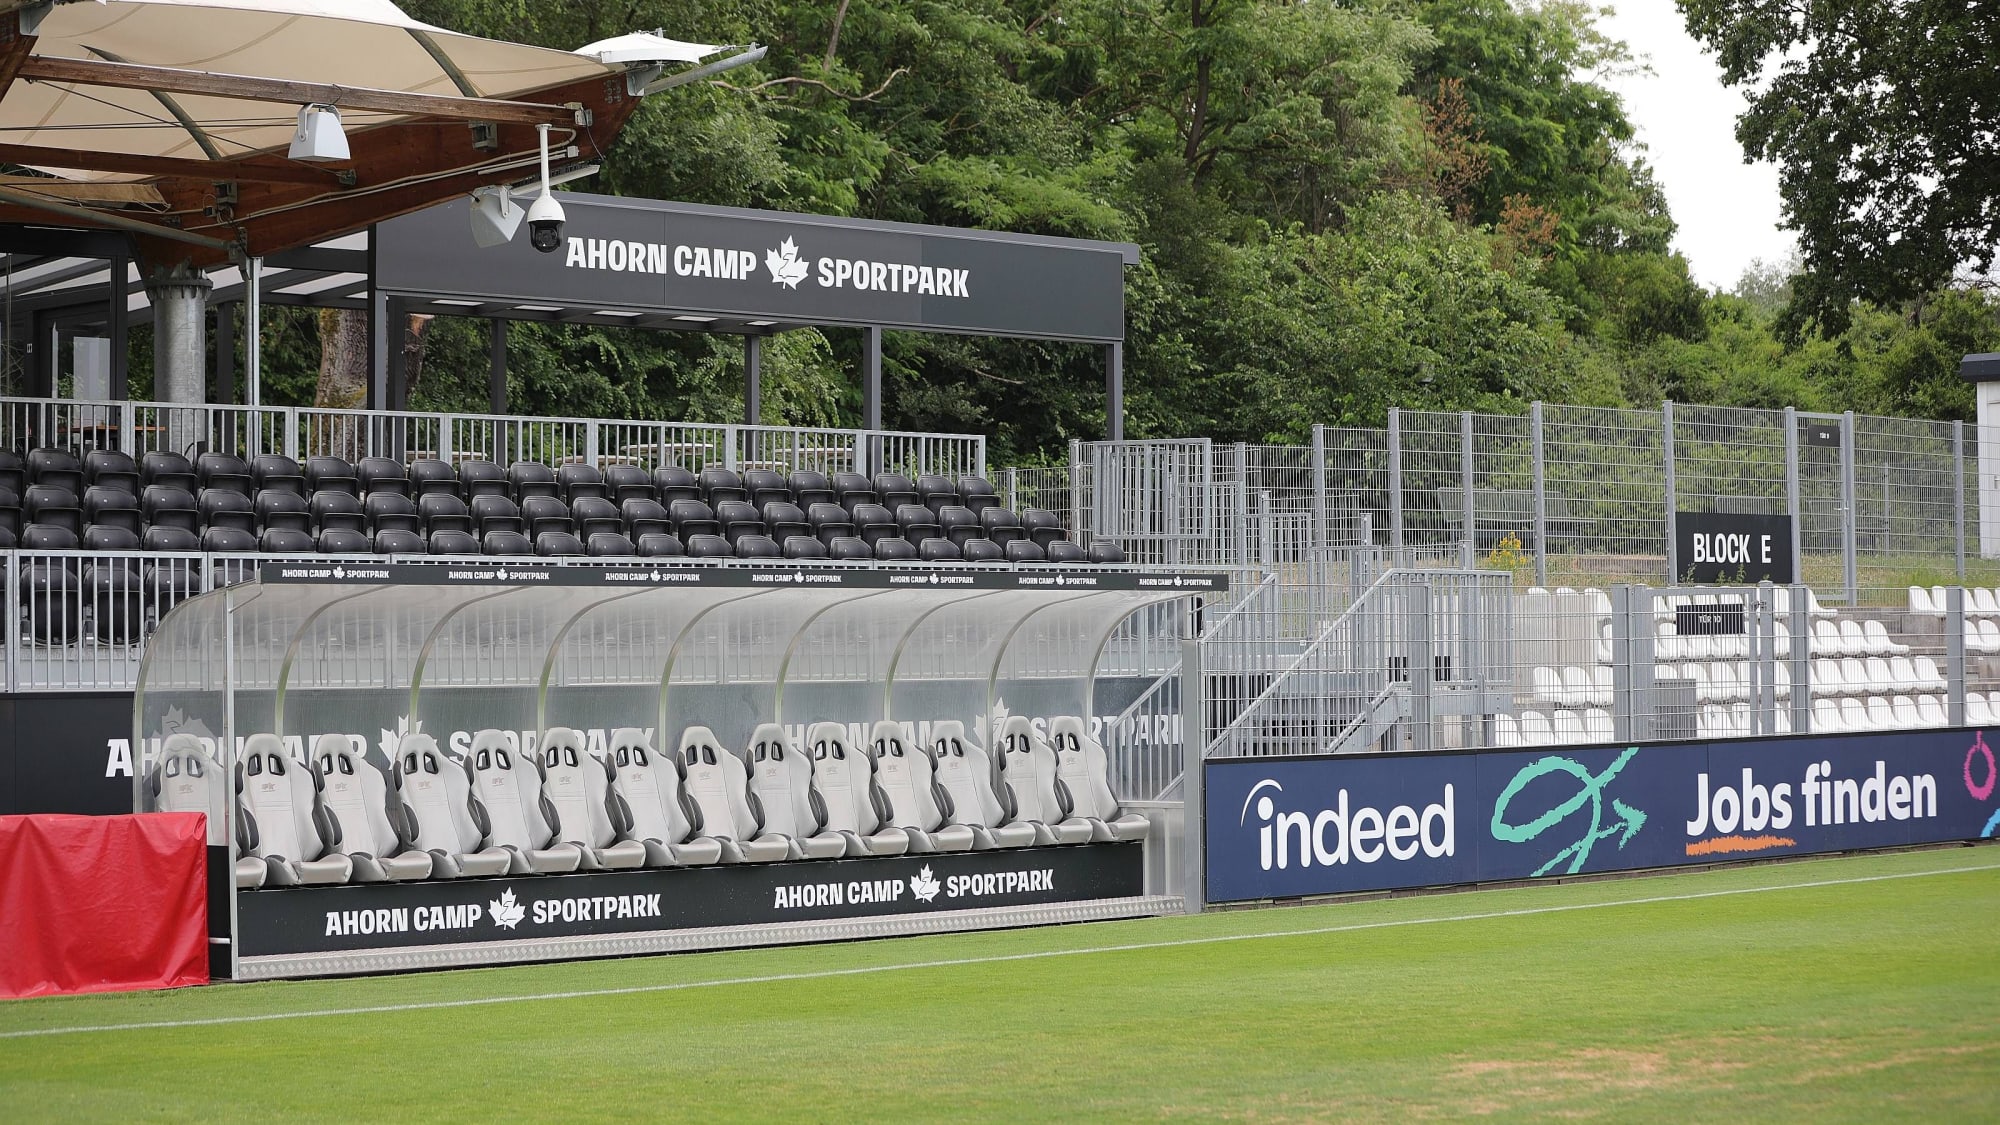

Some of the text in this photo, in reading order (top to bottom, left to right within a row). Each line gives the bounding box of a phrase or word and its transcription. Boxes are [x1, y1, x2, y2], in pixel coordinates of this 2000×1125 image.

[565, 237, 970, 298] AHORN CAMP SPORTPARK
[1693, 533, 1772, 564] BLOCK E
[282, 569, 390, 579] AHORN CAMP SPORTPARK
[448, 571, 550, 580] AHORN CAMP SPORTPARK
[605, 572, 700, 582] AHORN CAMP SPORTPARK
[752, 574, 842, 583] AHORN CAMP SPORTPARK
[890, 575, 974, 584] AHORN CAMP SPORTPARK
[1018, 577, 1097, 585] AHORN CAMP SPORTPARK
[1138, 578, 1157, 586] AHORN
[1687, 760, 1938, 837] Jobs finden
[1242, 780, 1455, 871] indeed
[773, 869, 1055, 909] AHORN CAMP SPORTPARK
[325, 893, 662, 937] AHORN CAMP SPORTPARK
